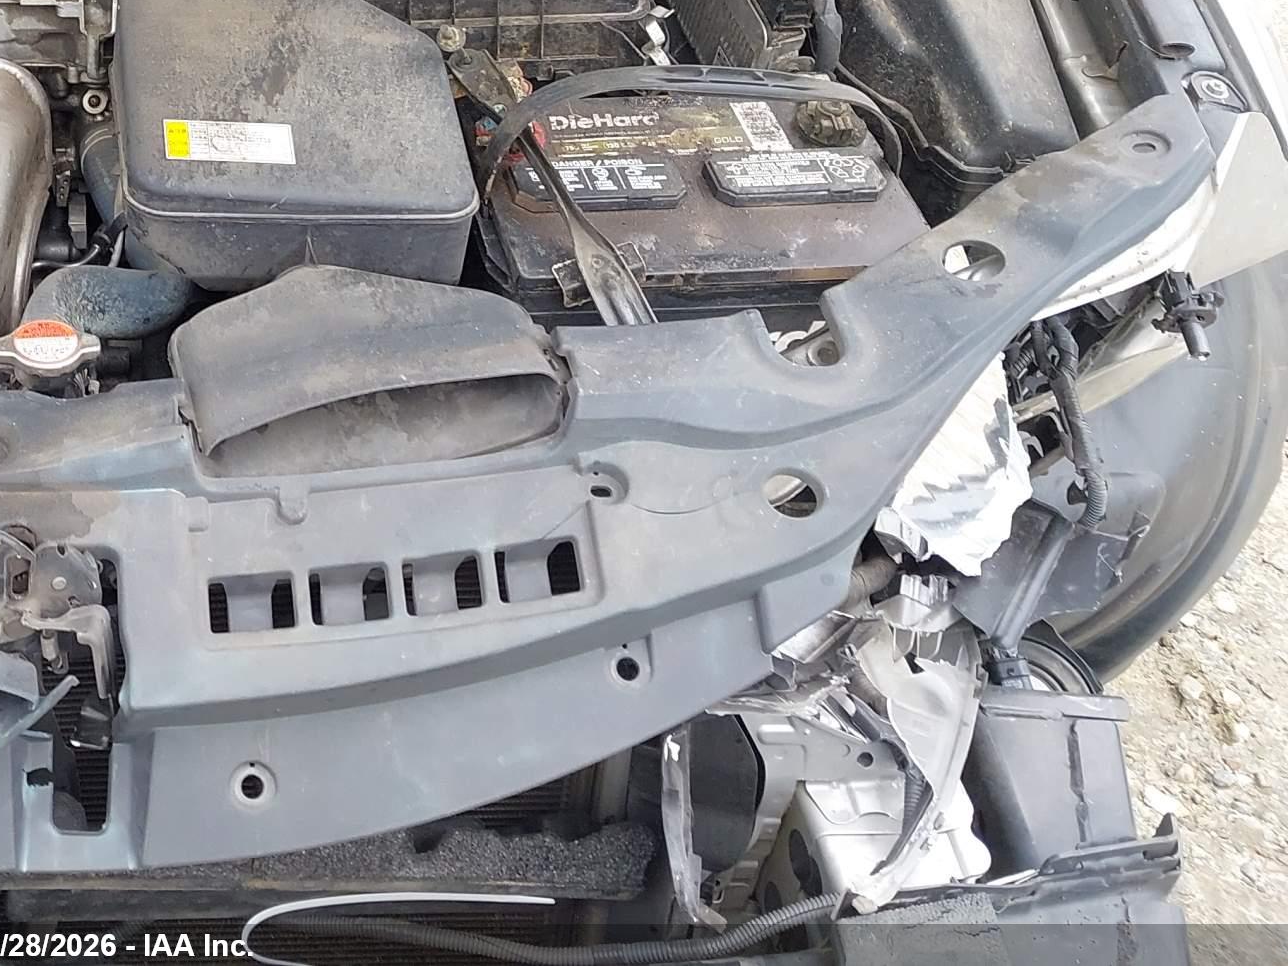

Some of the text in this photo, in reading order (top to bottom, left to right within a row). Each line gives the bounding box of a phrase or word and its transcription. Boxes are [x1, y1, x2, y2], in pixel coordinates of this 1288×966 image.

[549, 112, 660, 131] DieHard
[713, 136, 744, 144] GOLD
[551, 160, 594, 168] DANGER
[604, 158, 643, 166] POISON
